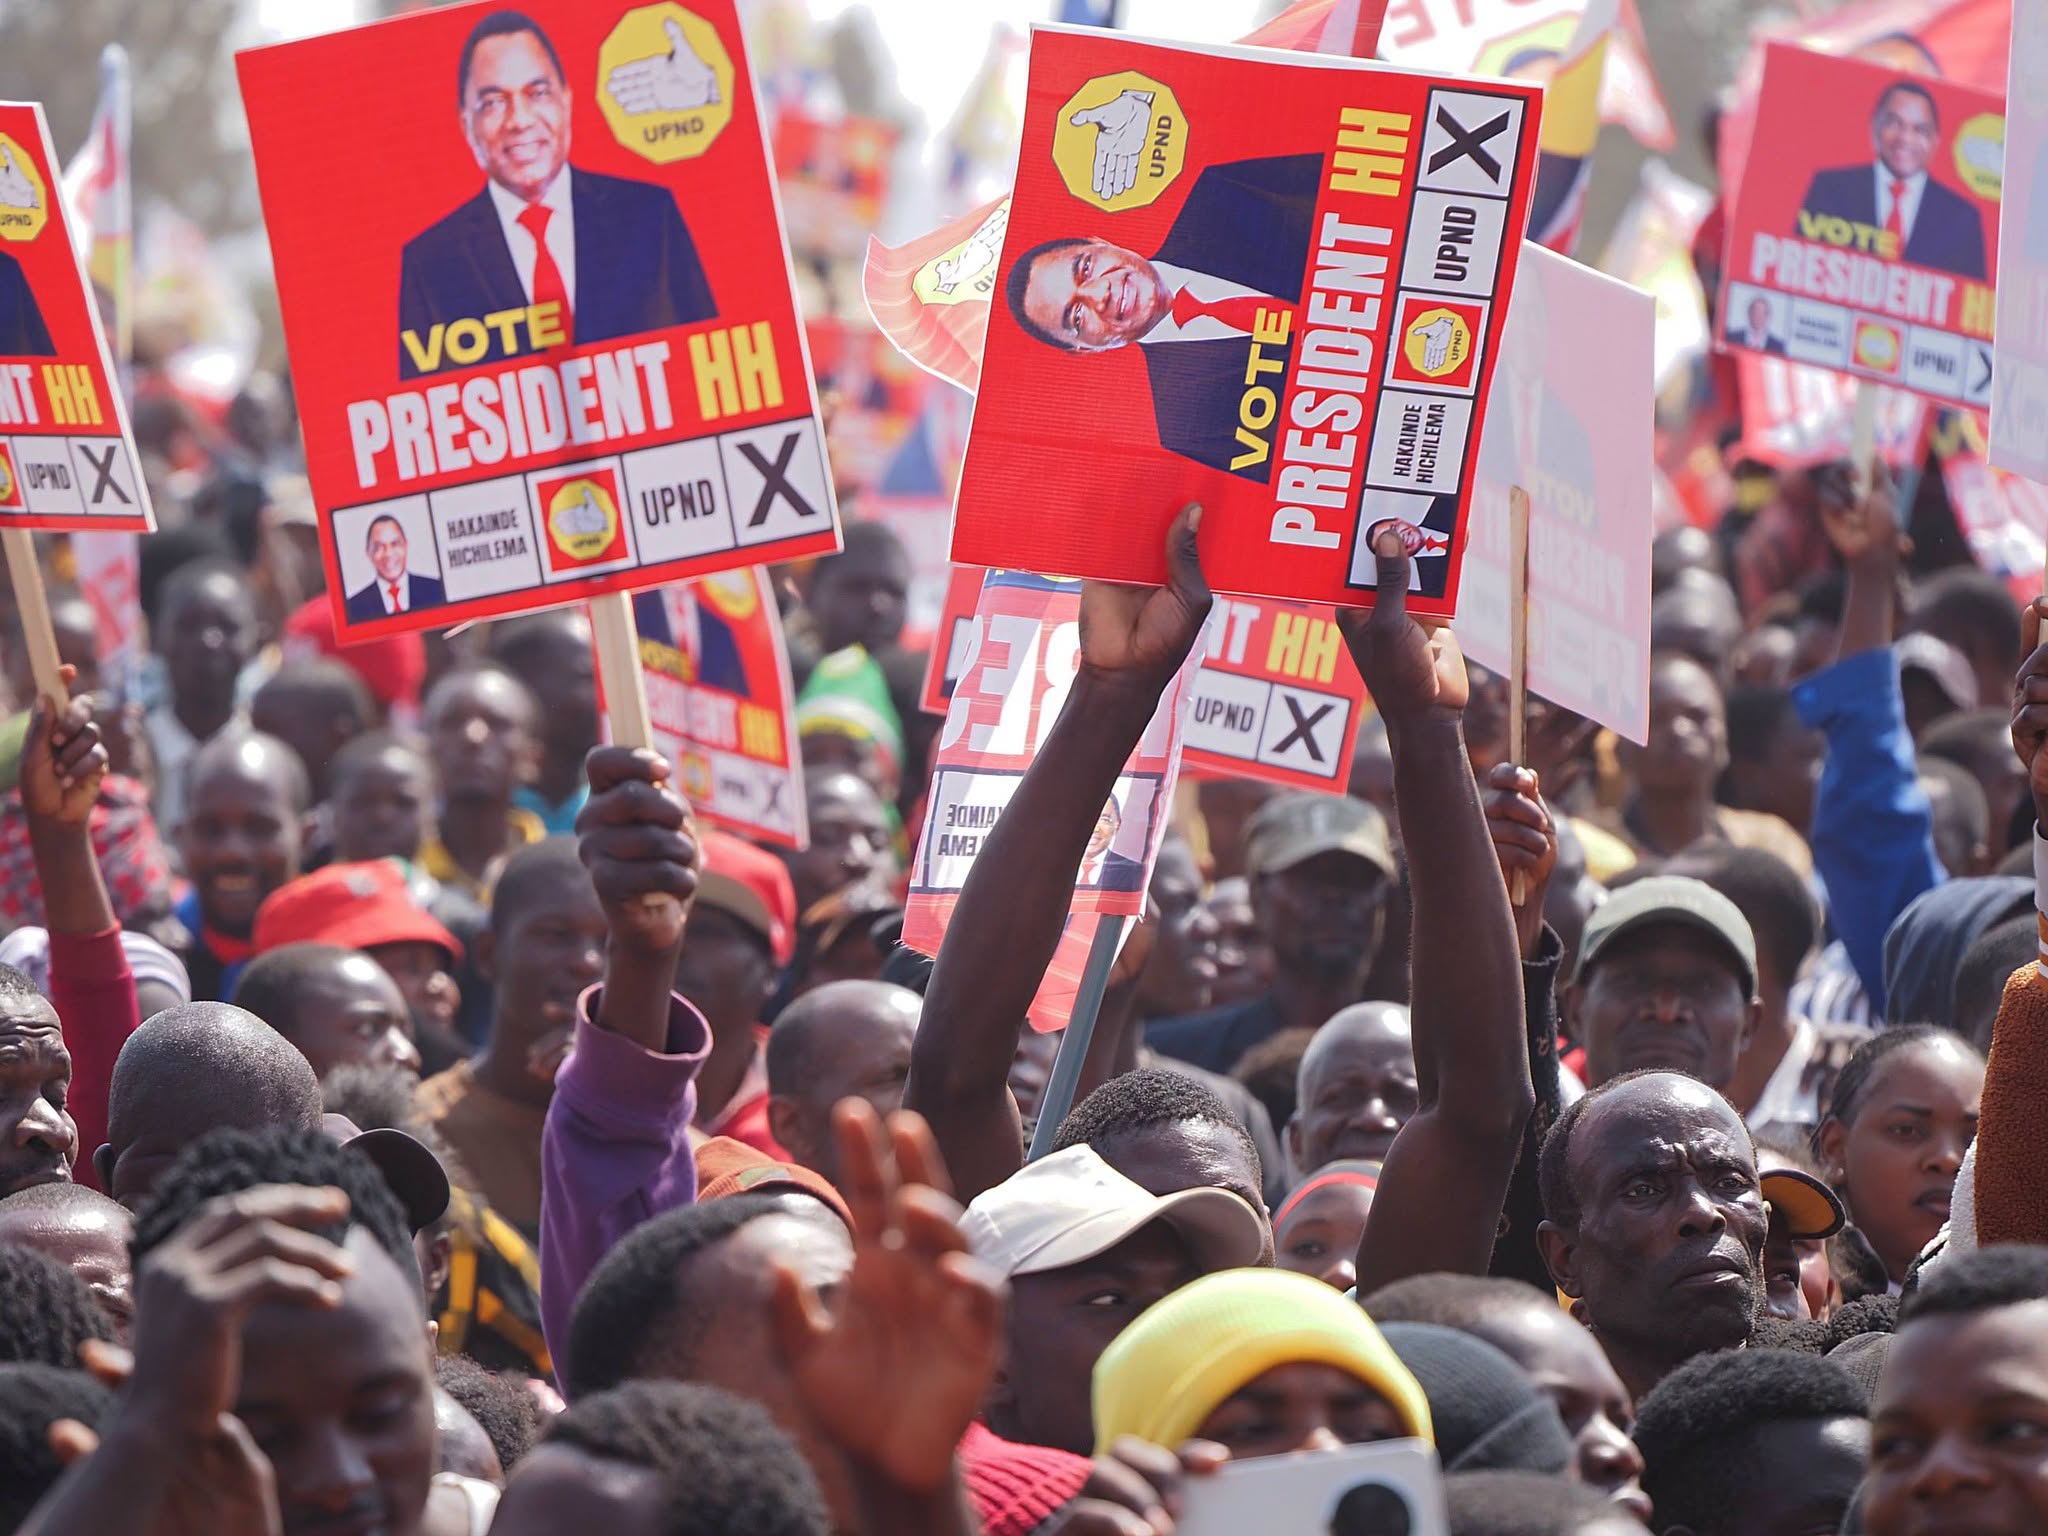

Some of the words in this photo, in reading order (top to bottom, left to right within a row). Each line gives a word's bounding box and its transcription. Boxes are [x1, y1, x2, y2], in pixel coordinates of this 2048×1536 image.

[643, 117, 704, 143] UPND
[1149, 115, 1172, 177] UPND
[1329, 107, 1412, 197] HH
[1433, 206, 1477, 282] UPND
[1798, 211, 1899, 261] VOTE
[1751, 232, 1956, 325] PRESIDENT
[401, 301, 566, 373] VOTE
[1451, 329, 1463, 361] UPND
[41, 364, 104, 425] HH
[347, 340, 674, 489] PRESIDENT
[688, 320, 784, 421] HH
[1230, 307, 1293, 471] VOTE
[1269, 212, 1393, 549] PRESIDENT
[1393, 403, 1422, 477] HAKAINDE
[1415, 402, 1446, 484] HICHILEMA
[25, 464, 71, 490] UPND
[642, 480, 715, 526] UPND
[447, 508, 519, 540] HAKAINDE
[447, 537, 528, 568] HICHILEMA
[1265, 611, 1342, 684] HH
[1194, 697, 1255, 733] UPND
